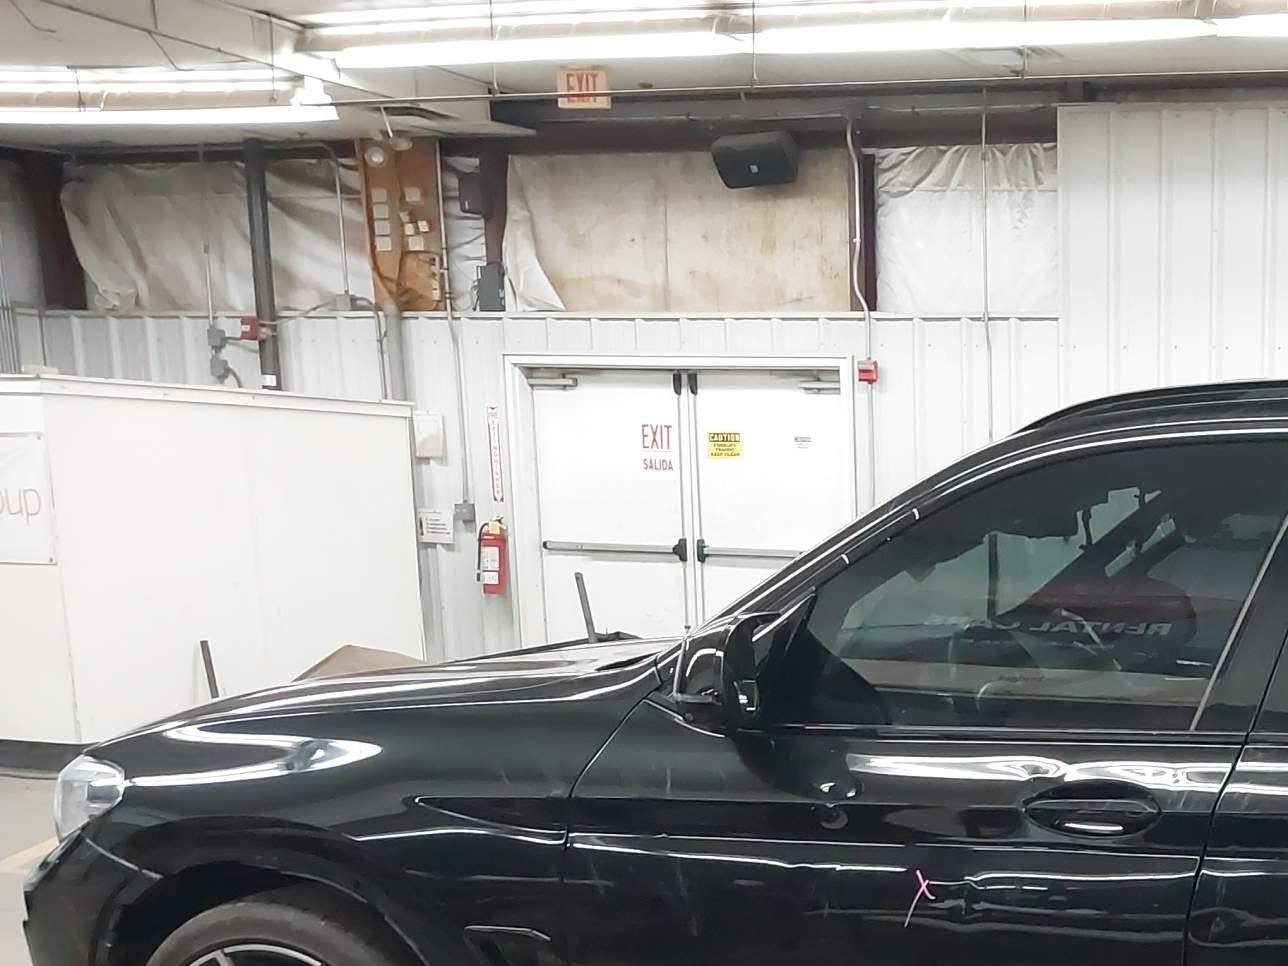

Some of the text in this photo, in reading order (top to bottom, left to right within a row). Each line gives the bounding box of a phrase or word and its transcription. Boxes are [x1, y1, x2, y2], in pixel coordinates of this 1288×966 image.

[565, 72, 599, 104] EXIT
[641, 423, 673, 450] EXIT
[642, 458, 675, 472] SALIDA
